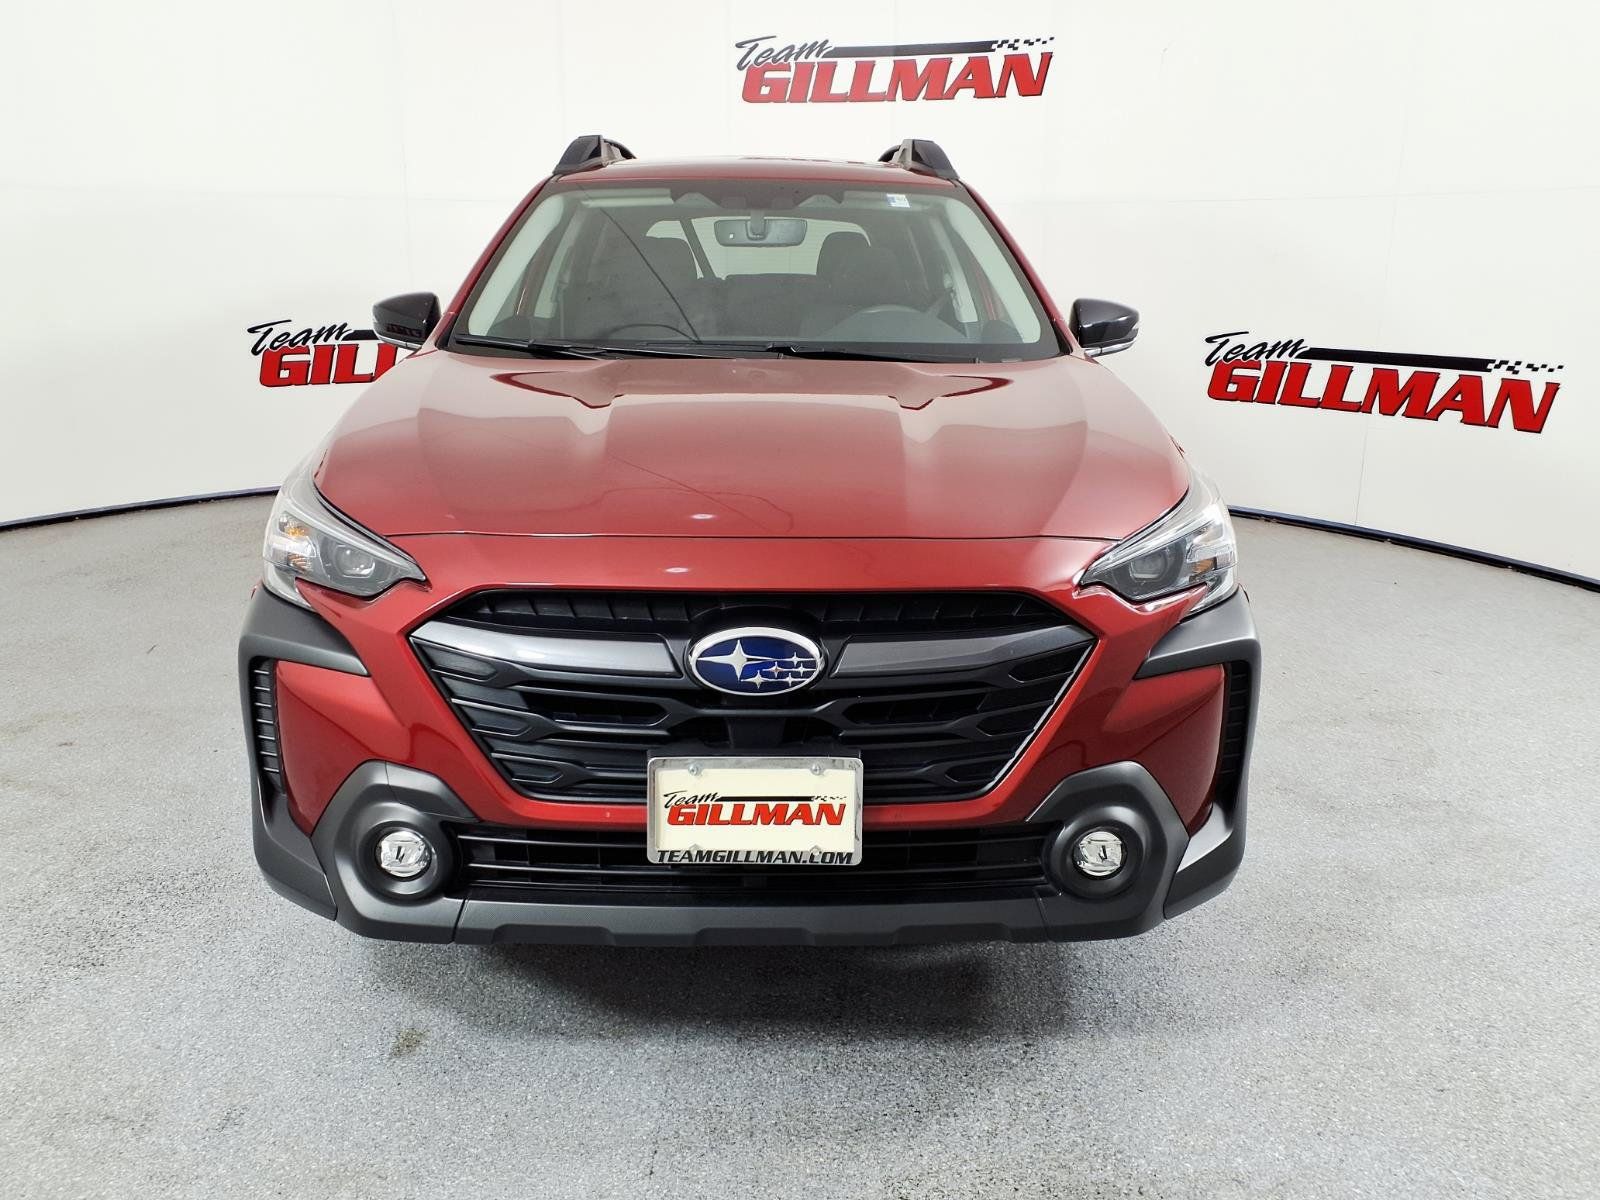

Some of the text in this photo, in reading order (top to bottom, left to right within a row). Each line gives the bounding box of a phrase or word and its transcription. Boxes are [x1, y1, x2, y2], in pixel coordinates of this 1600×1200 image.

[735, 36, 833, 72] Team
[742, 51, 1054, 103] GILLMAN
[247, 319, 350, 356] Team
[1205, 331, 1309, 366] Team
[1208, 359, 1561, 434] GILLMAN
[663, 790, 718, 809] Team
[667, 803, 846, 826] GILLMAN
[657, 850, 853, 864] TEAMGILLMAN.COM
